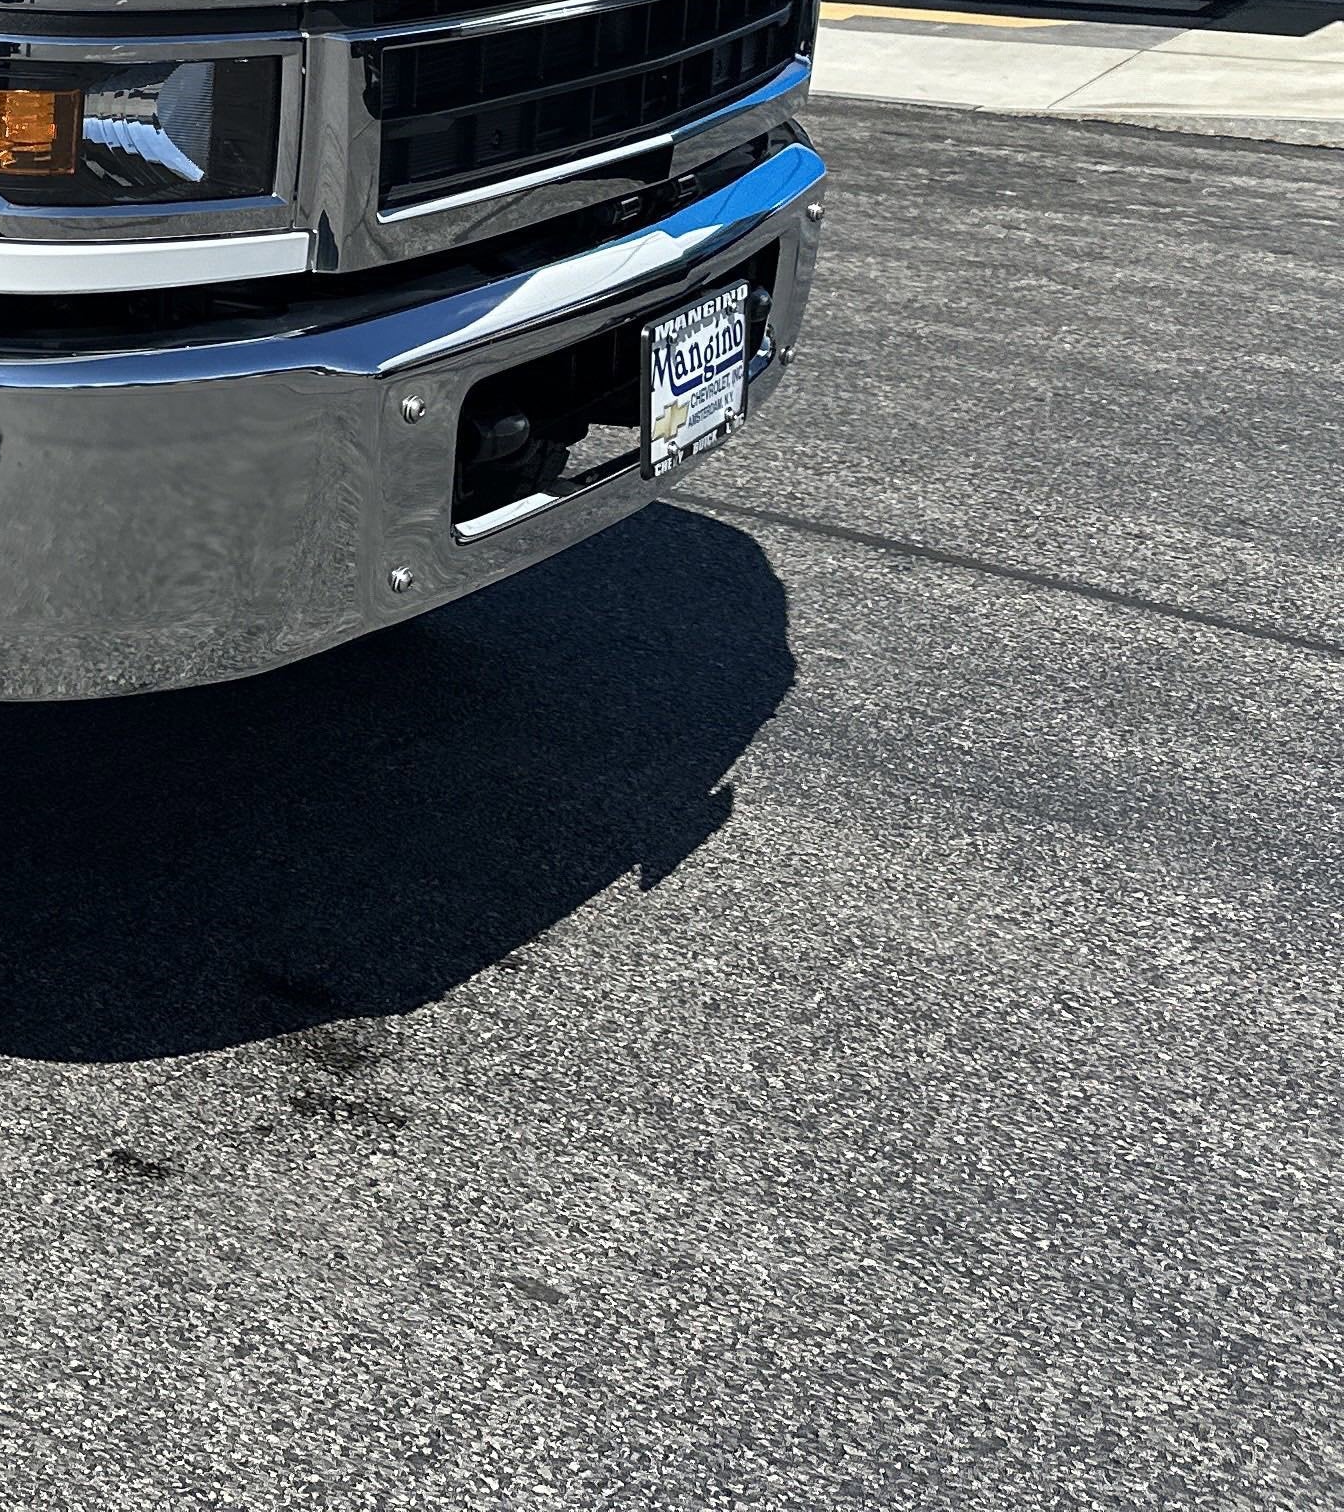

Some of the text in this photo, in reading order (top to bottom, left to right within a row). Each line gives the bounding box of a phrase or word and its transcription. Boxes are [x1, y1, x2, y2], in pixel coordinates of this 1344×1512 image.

[654, 284, 749, 342] MANGINO
[651, 319, 744, 392] Mangino
[692, 429, 718, 455] BUICK
